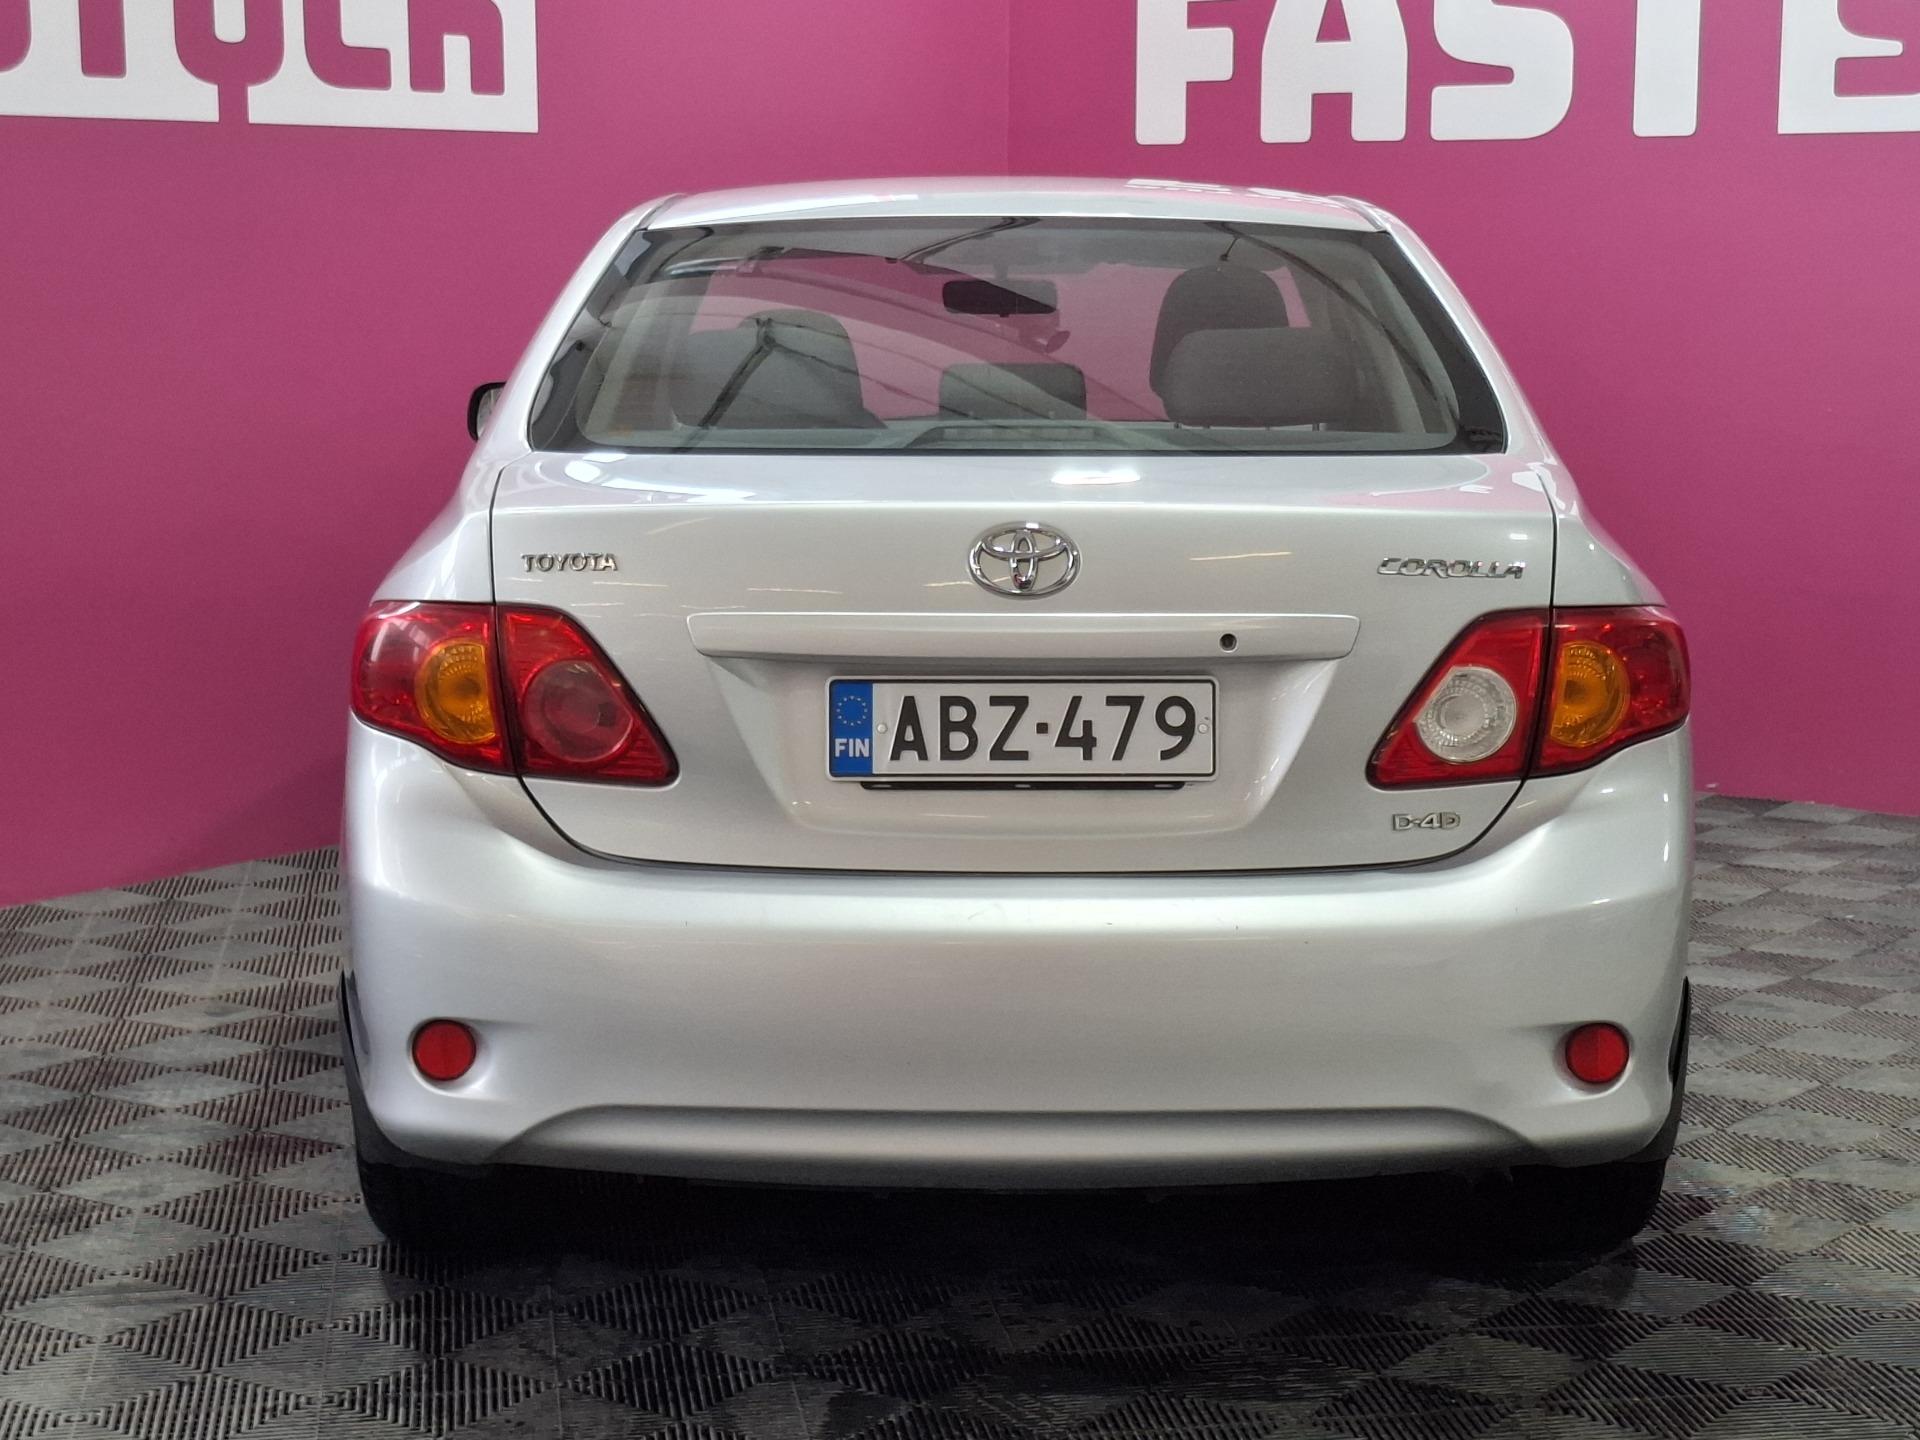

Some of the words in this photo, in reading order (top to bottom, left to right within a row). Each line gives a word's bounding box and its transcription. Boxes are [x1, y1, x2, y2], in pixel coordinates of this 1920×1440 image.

[521, 552, 618, 572] TOYOTA
[1377, 557, 1527, 579] COROLLA
[834, 738, 870, 758] FIN
[1392, 811, 1461, 832] D-4D
